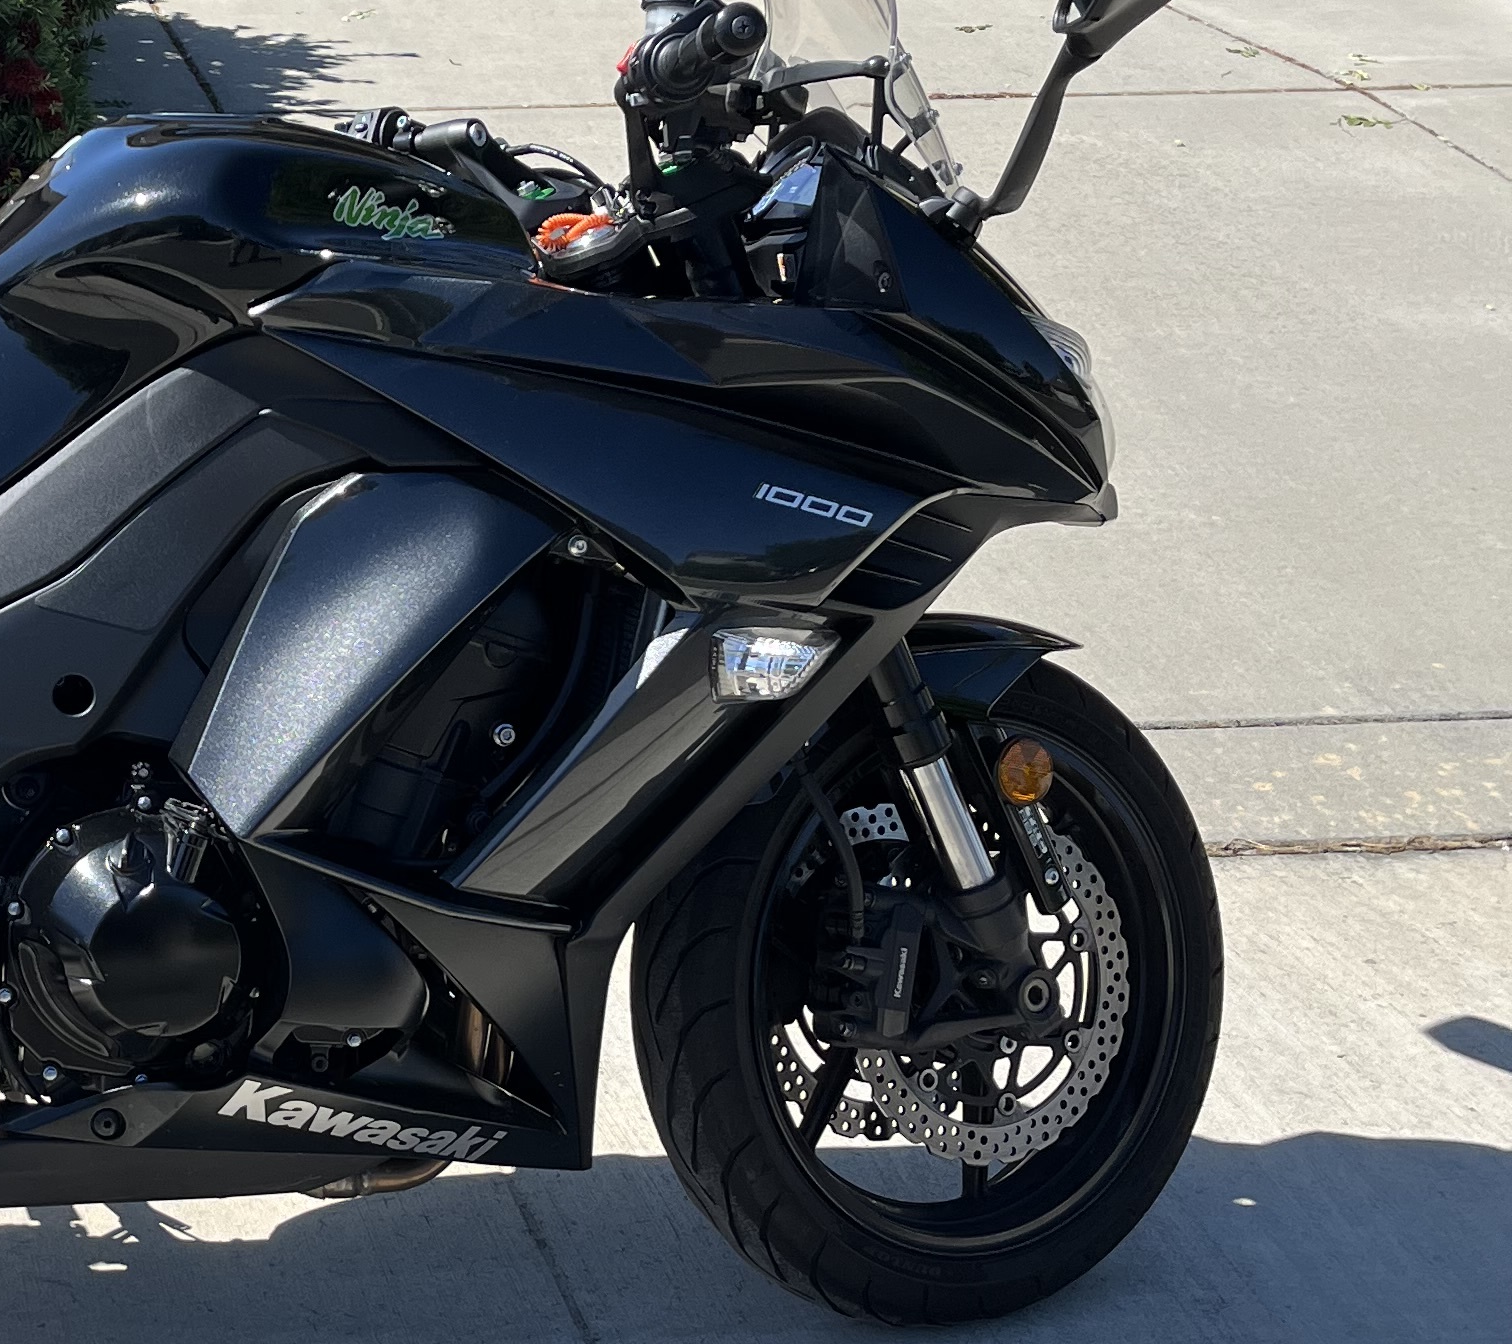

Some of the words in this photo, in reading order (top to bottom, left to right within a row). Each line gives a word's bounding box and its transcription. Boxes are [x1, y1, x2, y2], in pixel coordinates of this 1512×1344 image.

[333, 186, 445, 240] Ninja
[753, 482, 874, 528] 1000
[893, 947, 908, 998] Kawasaki
[217, 1079, 508, 1161] Kawasaki
